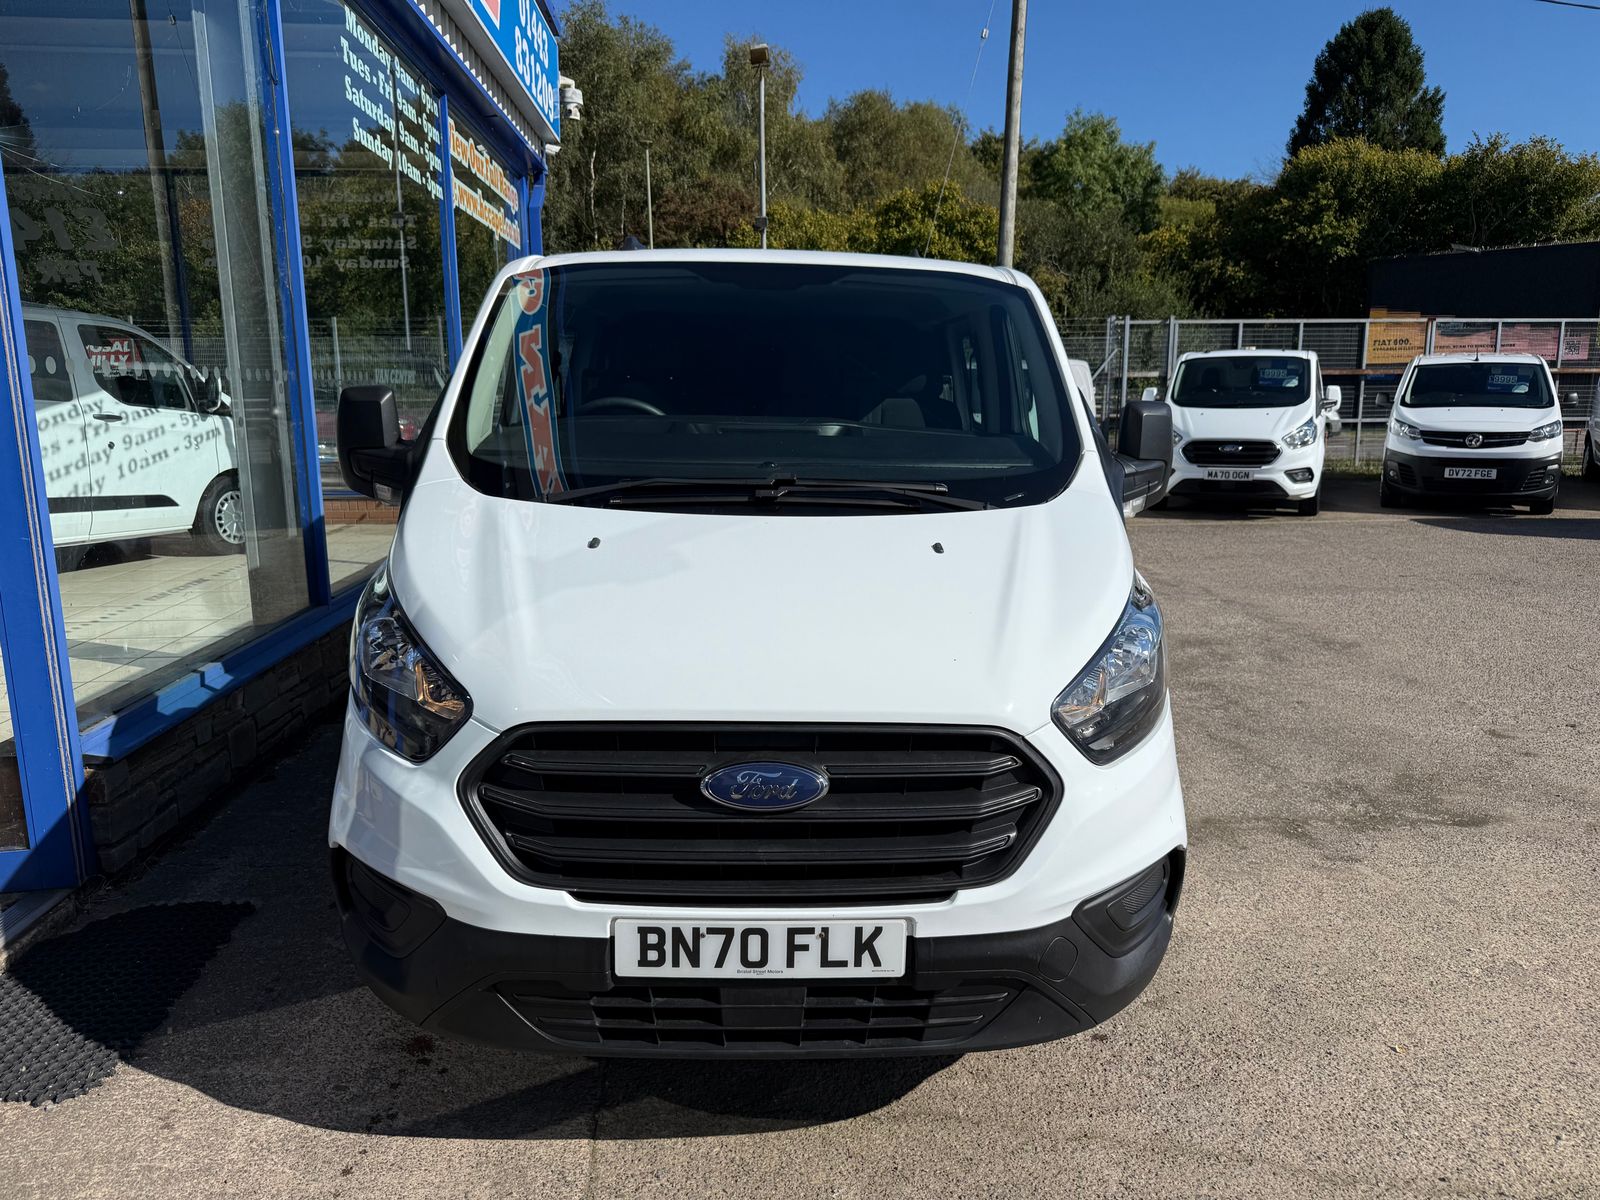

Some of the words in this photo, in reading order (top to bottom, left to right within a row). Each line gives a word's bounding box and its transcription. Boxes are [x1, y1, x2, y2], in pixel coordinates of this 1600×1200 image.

[518, 0, 549, 69] 01443
[344, 4, 392, 75] Monday
[394, 56, 416, 95] 9am
[420, 84, 439, 117] 6pm
[514, 25, 554, 123] 831209
[340, 36, 371, 84] Tues
[378, 70, 394, 104] Fri
[396, 88, 417, 125] 9am
[422, 112, 441, 145] 6pm
[344, 75, 396, 141] Saturday
[399, 120, 420, 155] 9am
[424, 141, 443, 174] 5pm
[352, 117, 393, 171] Sunday
[397, 150, 422, 185] 10am
[426, 171, 444, 200] 3pm
[469, 137, 485, 180] Our
[1373, 338, 1391, 346] FIAT
[375, 368, 390, 385] VAN
[390, 368, 416, 385] CENTRE
[179, 413, 201, 427] 5p
[117, 448, 169, 479] 10am
[183, 427, 222, 450] 3pm
[1207, 470, 1231, 479] MA70
[1232, 471, 1250, 479] OGN
[1448, 469, 1472, 477] DV72
[1474, 469, 1493, 478] FGE
[730, 770, 798, 799] Ford
[637, 926, 769, 969] BN70
[786, 926, 884, 968] FLK
